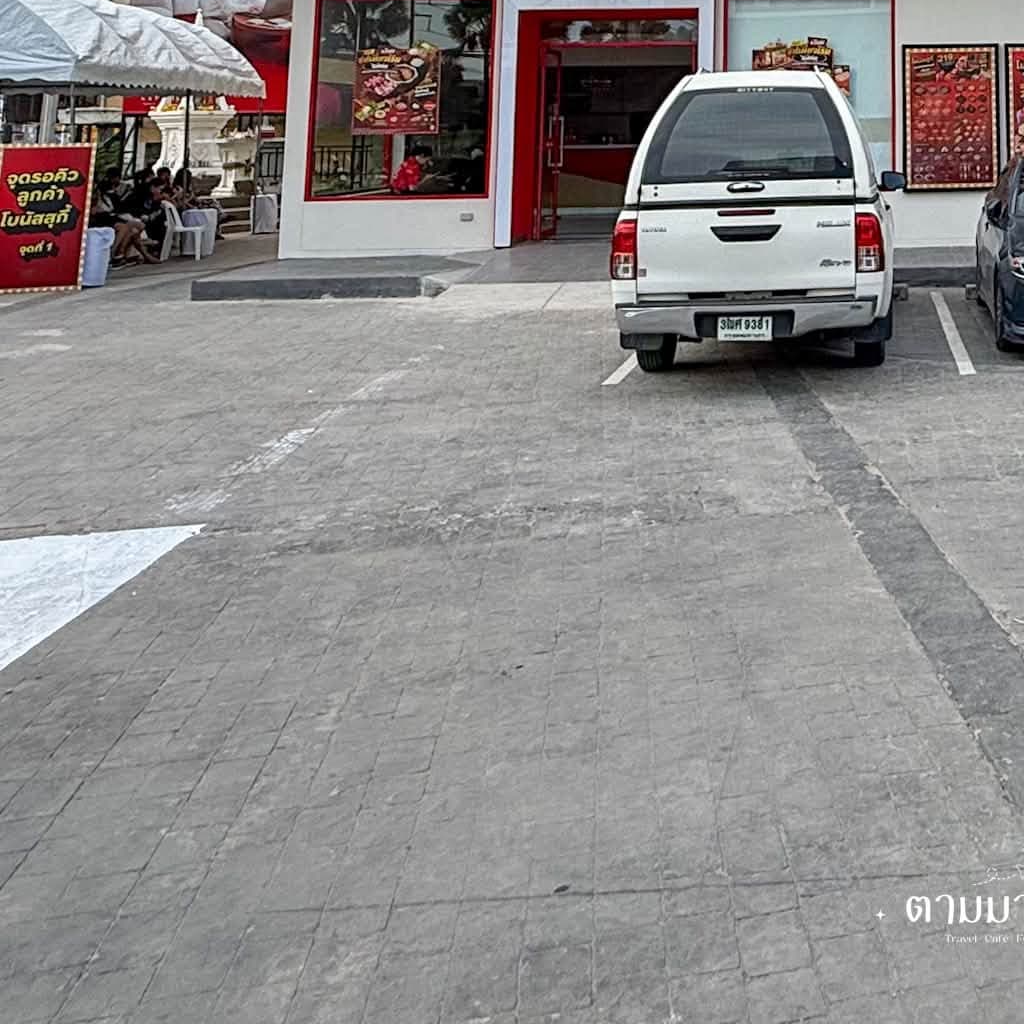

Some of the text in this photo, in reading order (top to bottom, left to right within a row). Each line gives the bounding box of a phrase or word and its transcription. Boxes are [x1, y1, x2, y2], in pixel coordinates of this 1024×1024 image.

[7, 168, 79, 189] จุดรอคิว
[17, 185, 65, 207] ลูกค้า
[0, 204, 72, 228] โบนัสสุกี้
